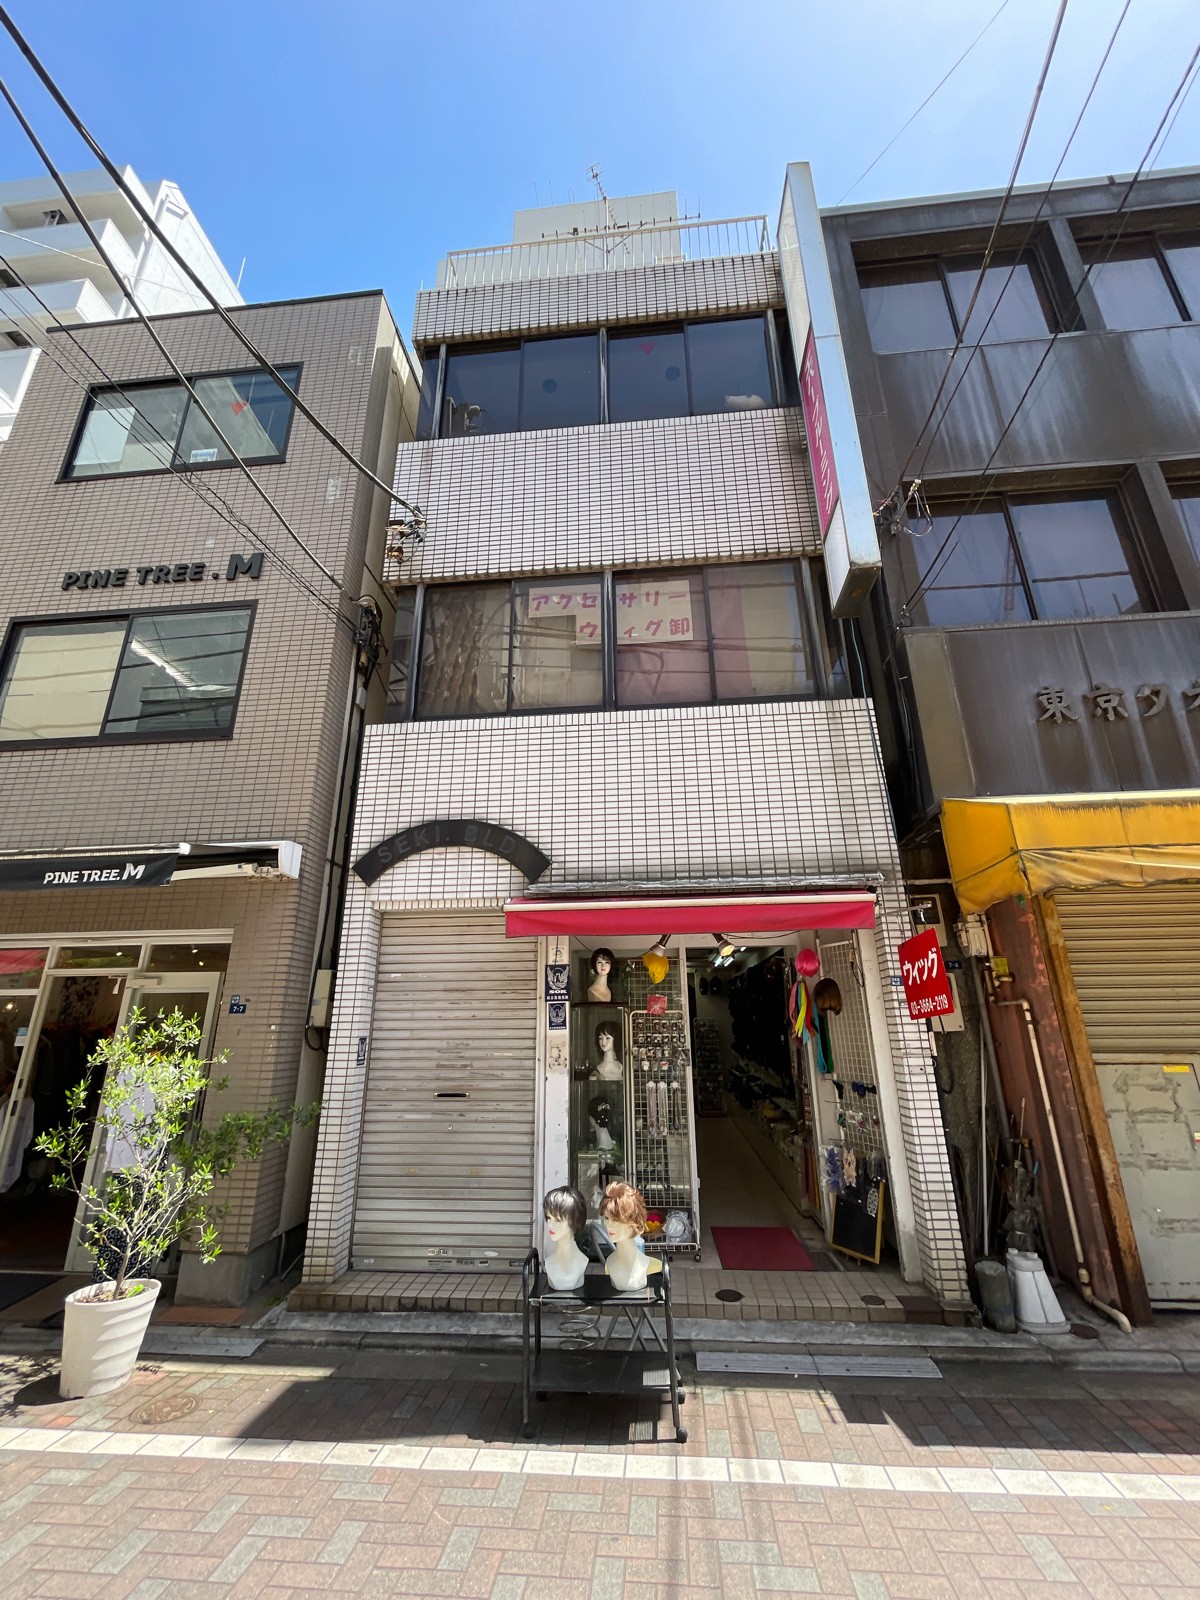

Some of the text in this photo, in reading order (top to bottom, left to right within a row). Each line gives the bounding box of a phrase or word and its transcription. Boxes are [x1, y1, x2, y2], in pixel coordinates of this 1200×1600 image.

[60, 567, 129, 591] PINE
[136, 561, 206, 585] TREE
[43, 870, 80, 884] PINE
[902, 947, 938, 986] ウィッグ
[910, 994, 949, 1015] 03-3664-2119
